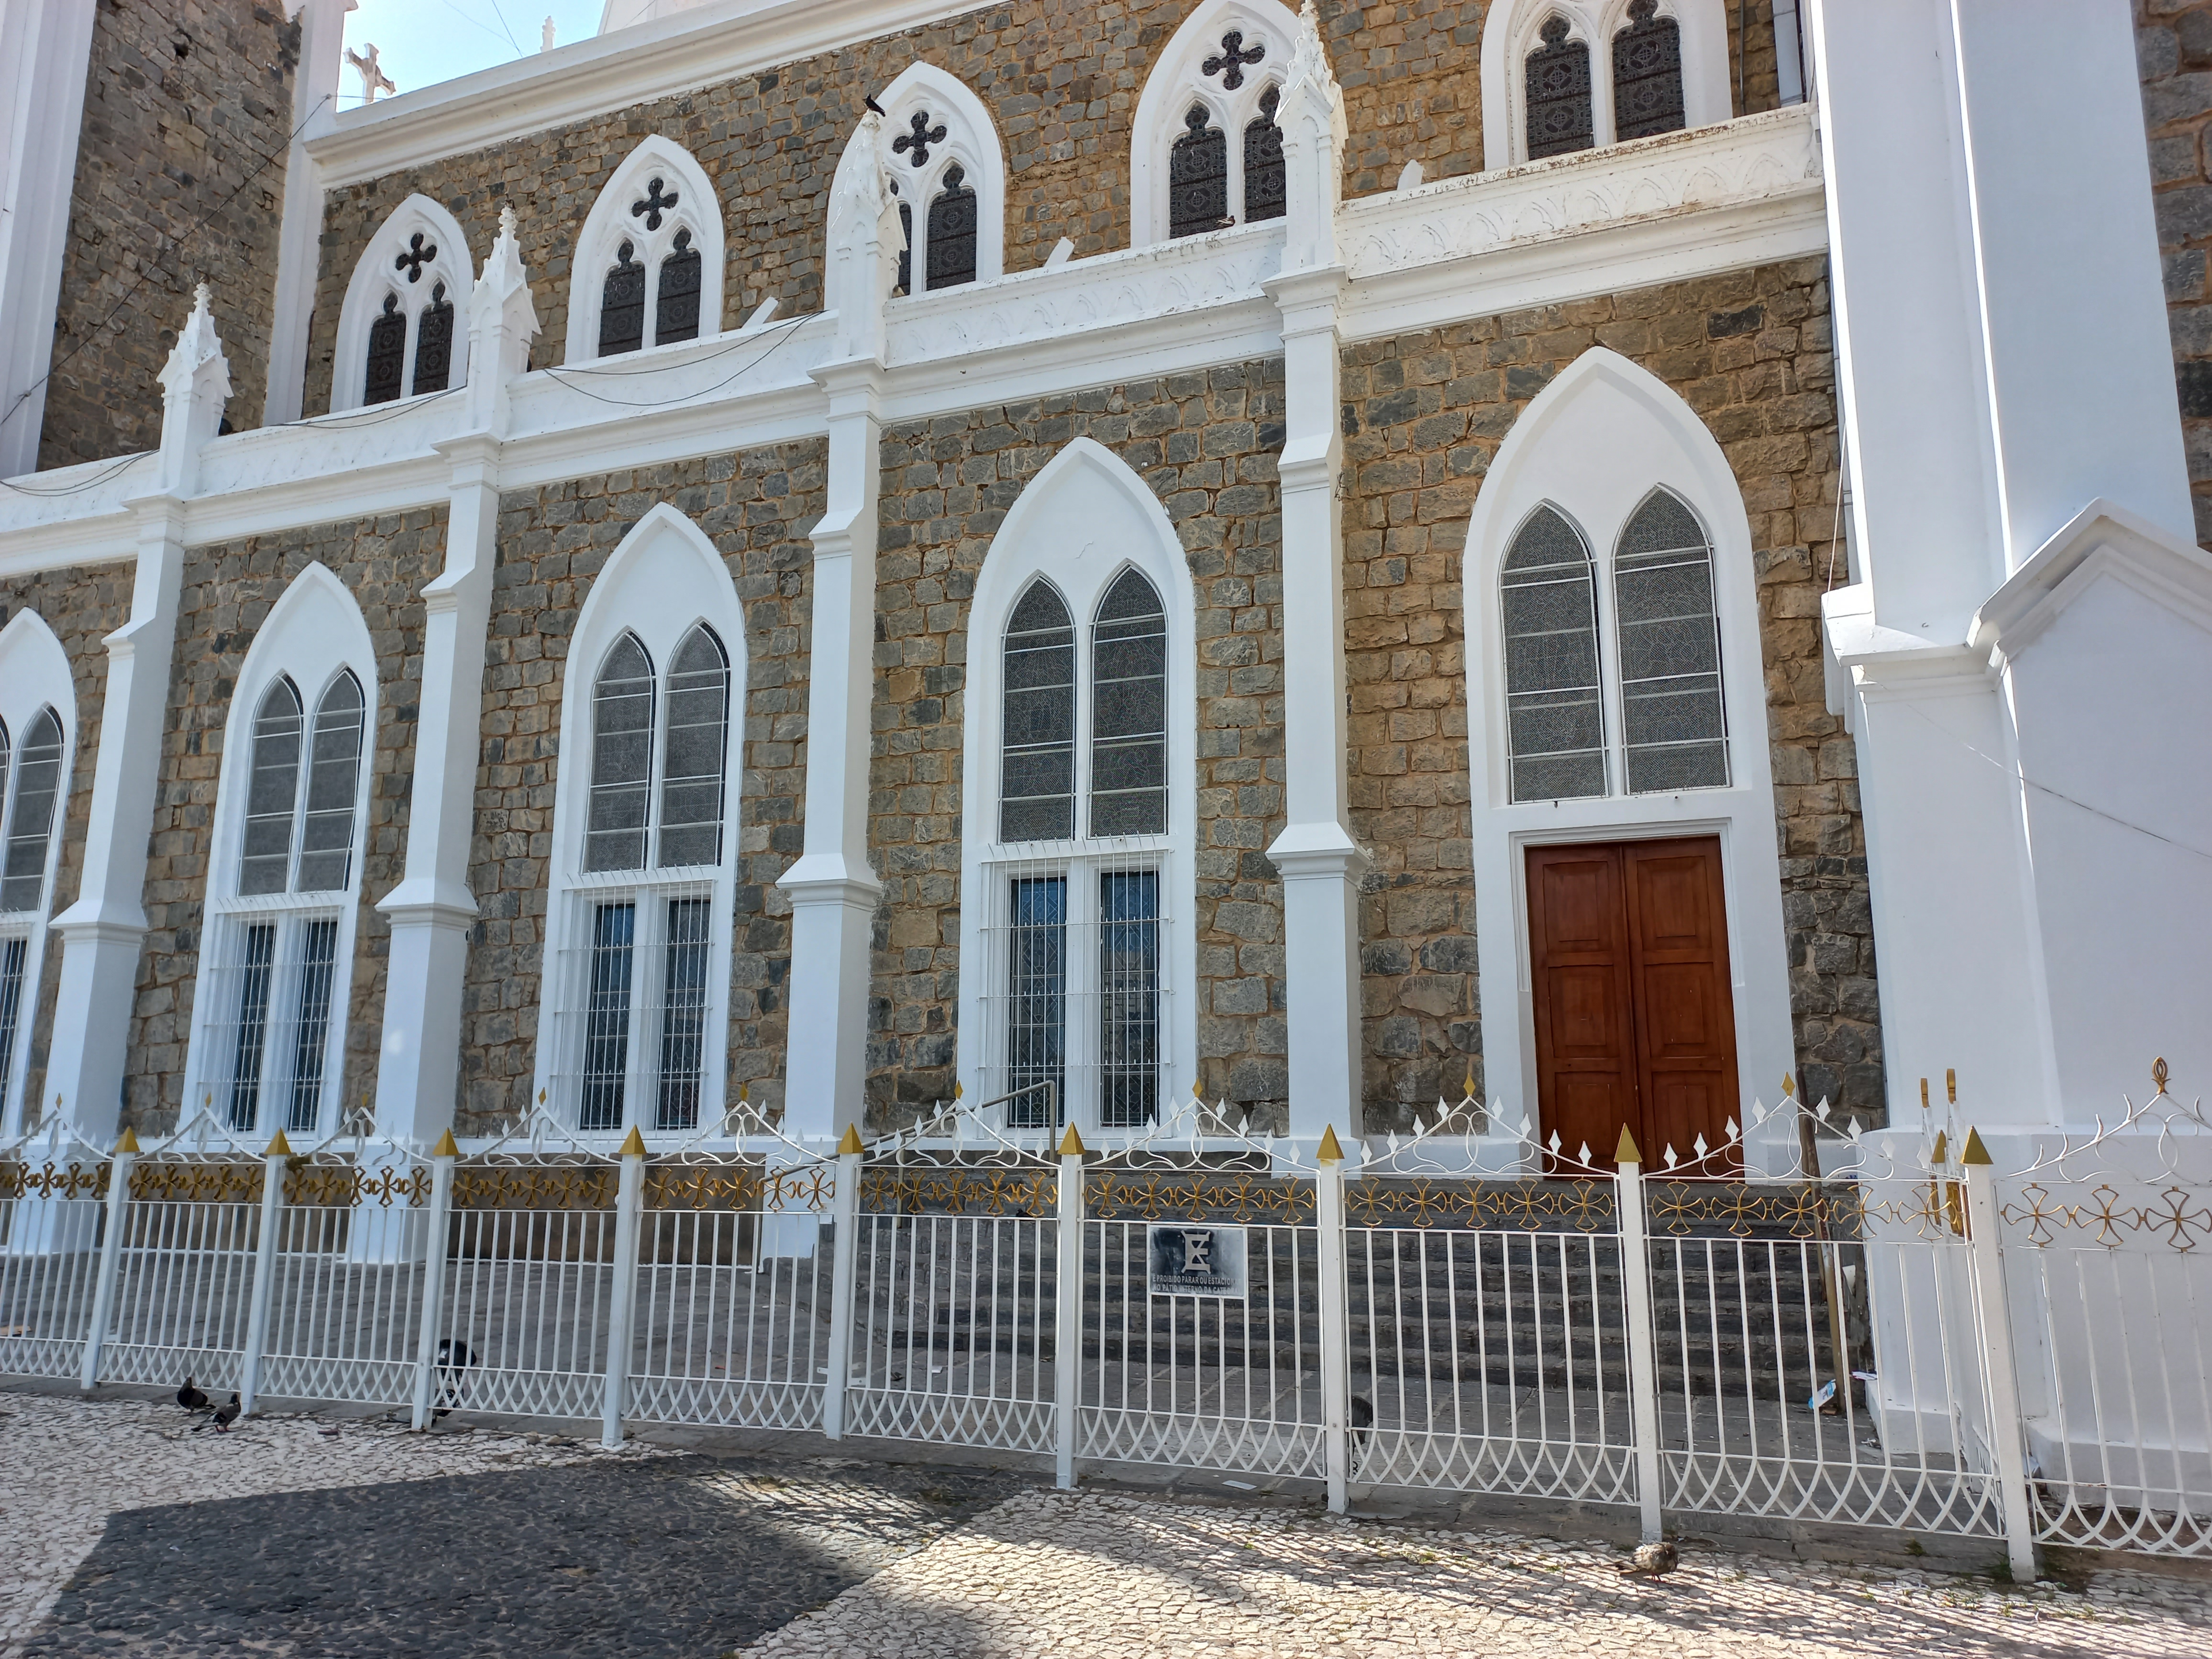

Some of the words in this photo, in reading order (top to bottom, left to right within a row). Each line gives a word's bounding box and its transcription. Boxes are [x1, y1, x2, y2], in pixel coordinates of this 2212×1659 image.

[1157, 1274, 1181, 1283] PROIBIDO
[1208, 1277, 1242, 1285] ESTACION
[1162, 1283, 1178, 1292] PÁTIO
